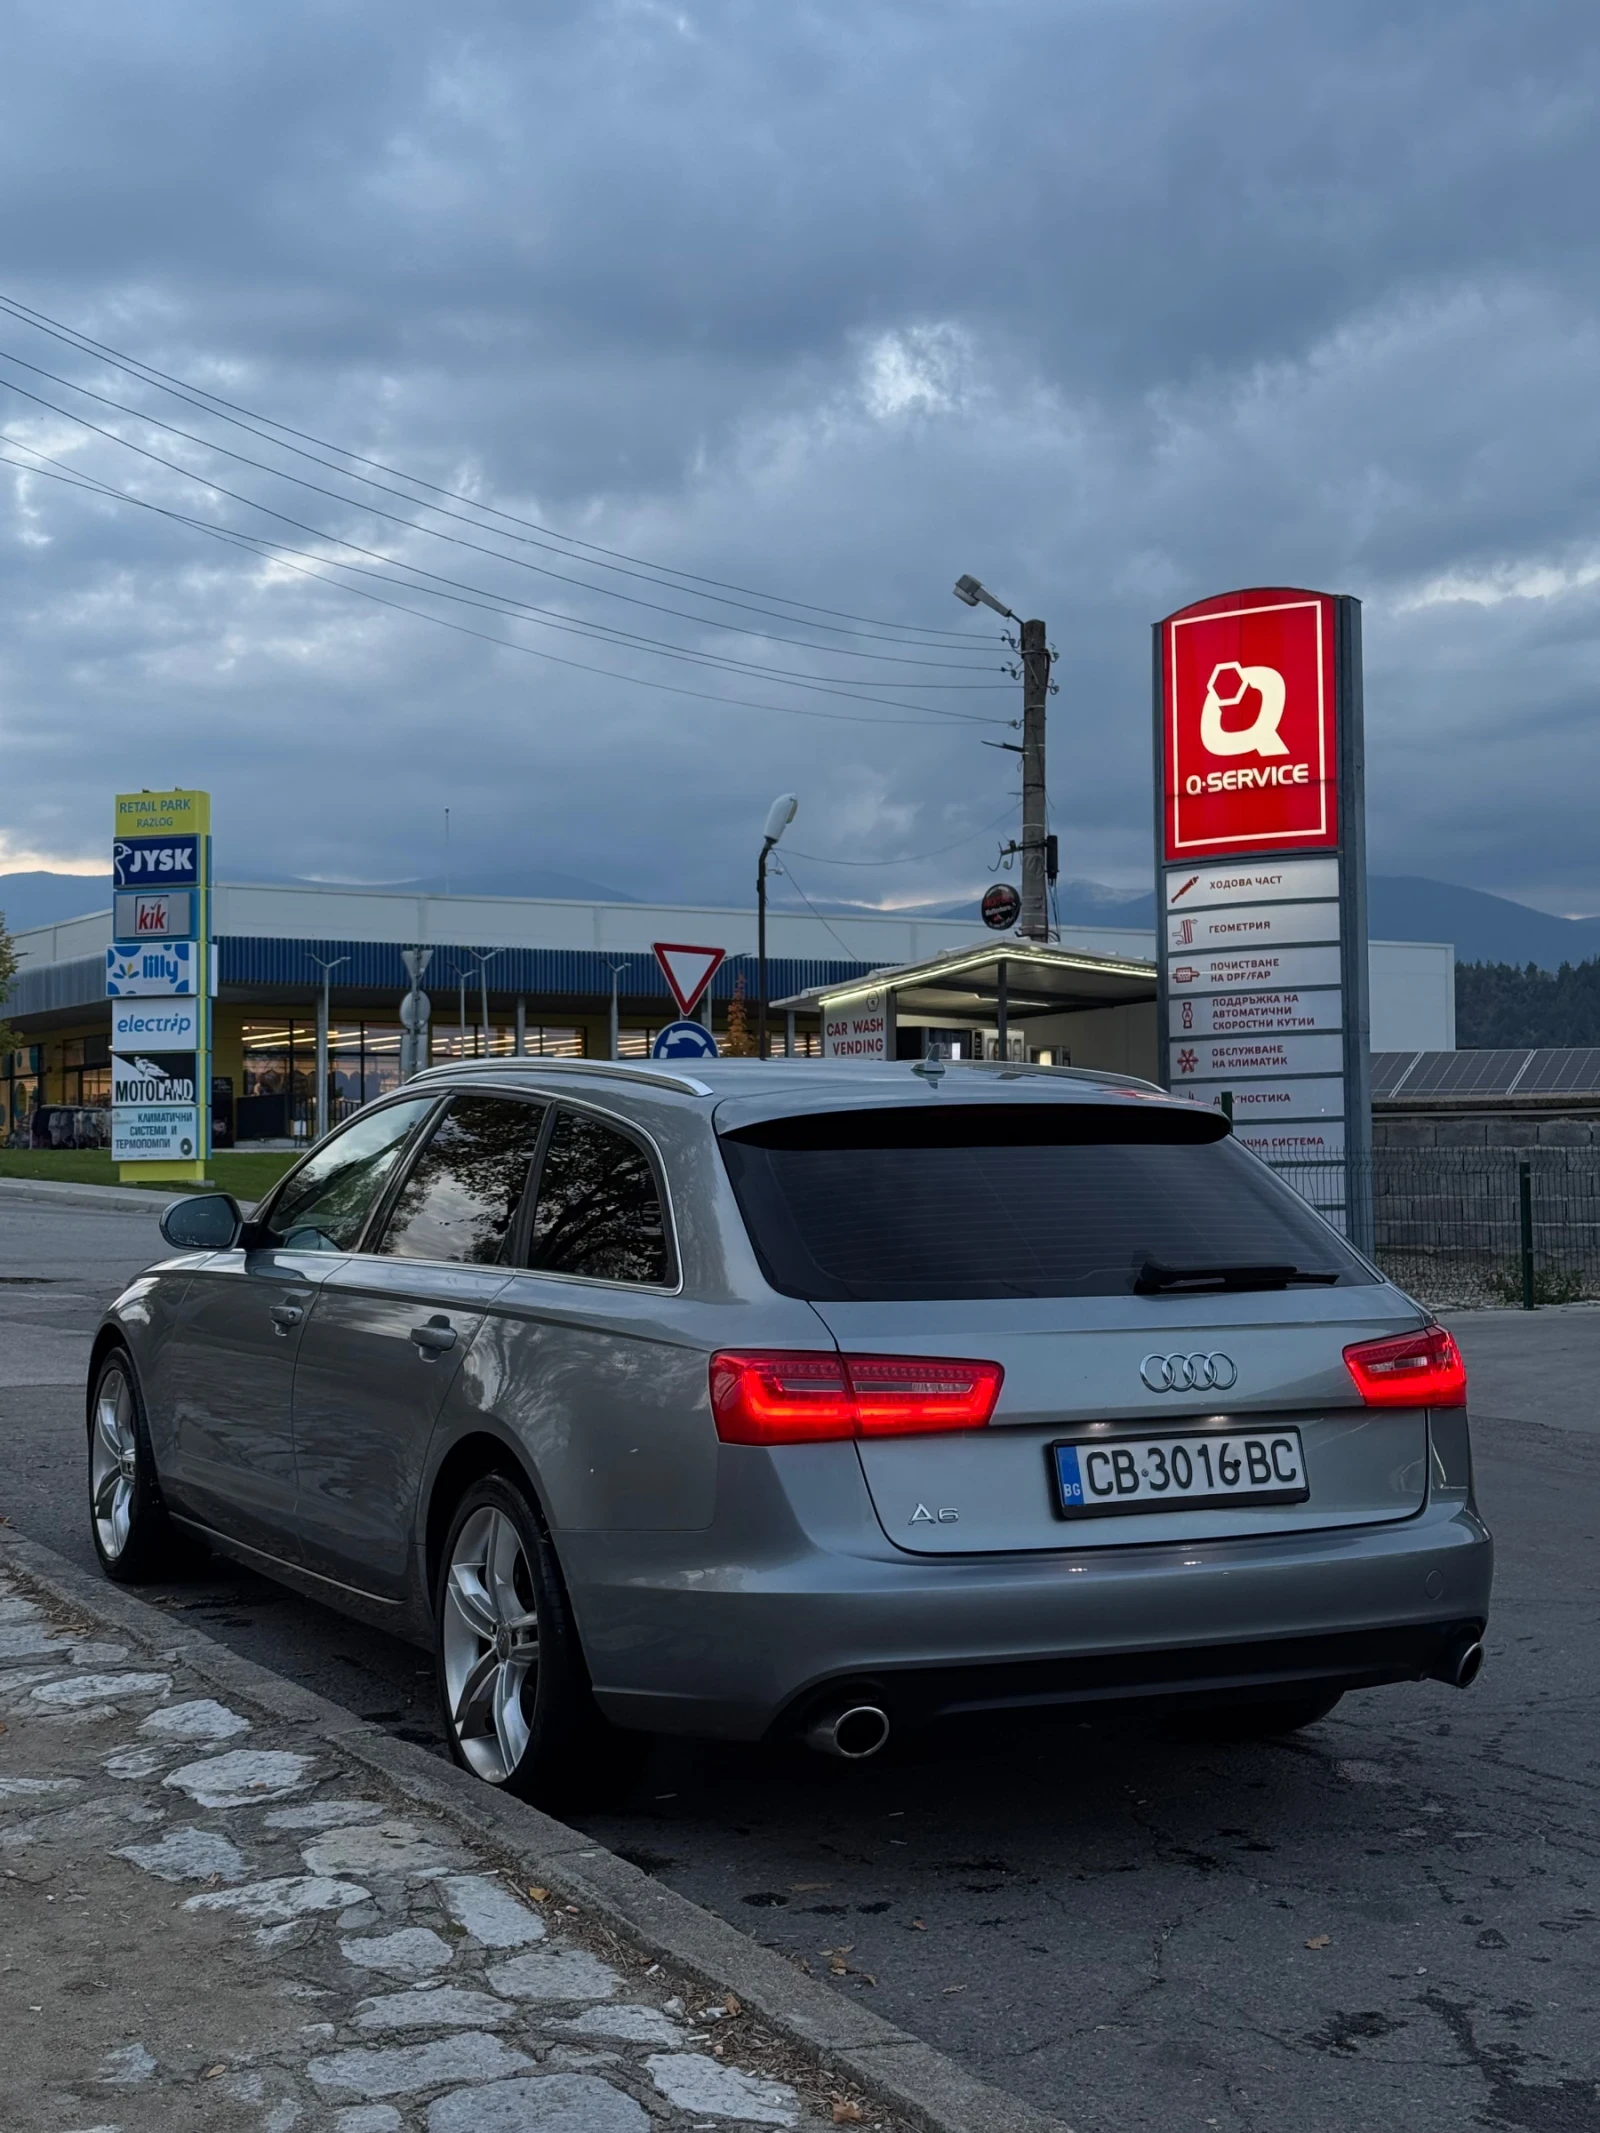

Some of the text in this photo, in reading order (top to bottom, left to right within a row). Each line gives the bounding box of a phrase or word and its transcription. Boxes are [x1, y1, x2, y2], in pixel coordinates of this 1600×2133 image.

[119, 799, 191, 814] RETAIL PARK
[136, 817, 173, 828] RAZLOG
[129, 848, 193, 873] JYSK
[1209, 875, 1283, 890] ХОДОВА ЧАСТ
[1209, 921, 1271, 933] ГЕОМЕТРИЯ
[143, 955, 178, 984] lilly
[1210, 958, 1280, 971] ПОЧИСТВАНЕ
[1210, 971, 1271, 983] НА DPF/FAP
[1212, 994, 1299, 1007] ПОДДРЪЖКА НА
[1212, 1006, 1292, 1019] АВТОМАТИЧНИ
[117, 1013, 191, 1035] electrip
[826, 1018, 884, 1037] CAR WASH
[1213, 1017, 1315, 1030] СКОРОСТНИ КУТИИ
[833, 1038, 884, 1056] VENDING
[1212, 1045, 1284, 1057] ОБСЛУЖВАНЕ
[1212, 1057, 1288, 1069] НА КЛИМАТИК
[115, 1078, 194, 1102] MOTOLAND
[1213, 1093, 1291, 1105] ДГНОСТИКА
[137, 1112, 193, 1123] КЛИМАТИЧНИ
[130, 1125, 178, 1136] СИСТЕМИ И
[115, 1138, 171, 1149] ТЕРМОПОМПИ
[1271, 1136, 1325, 1147] СИСТЕМА
[1063, 1484, 1081, 1497] BG
[908, 1503, 959, 1525] A6
